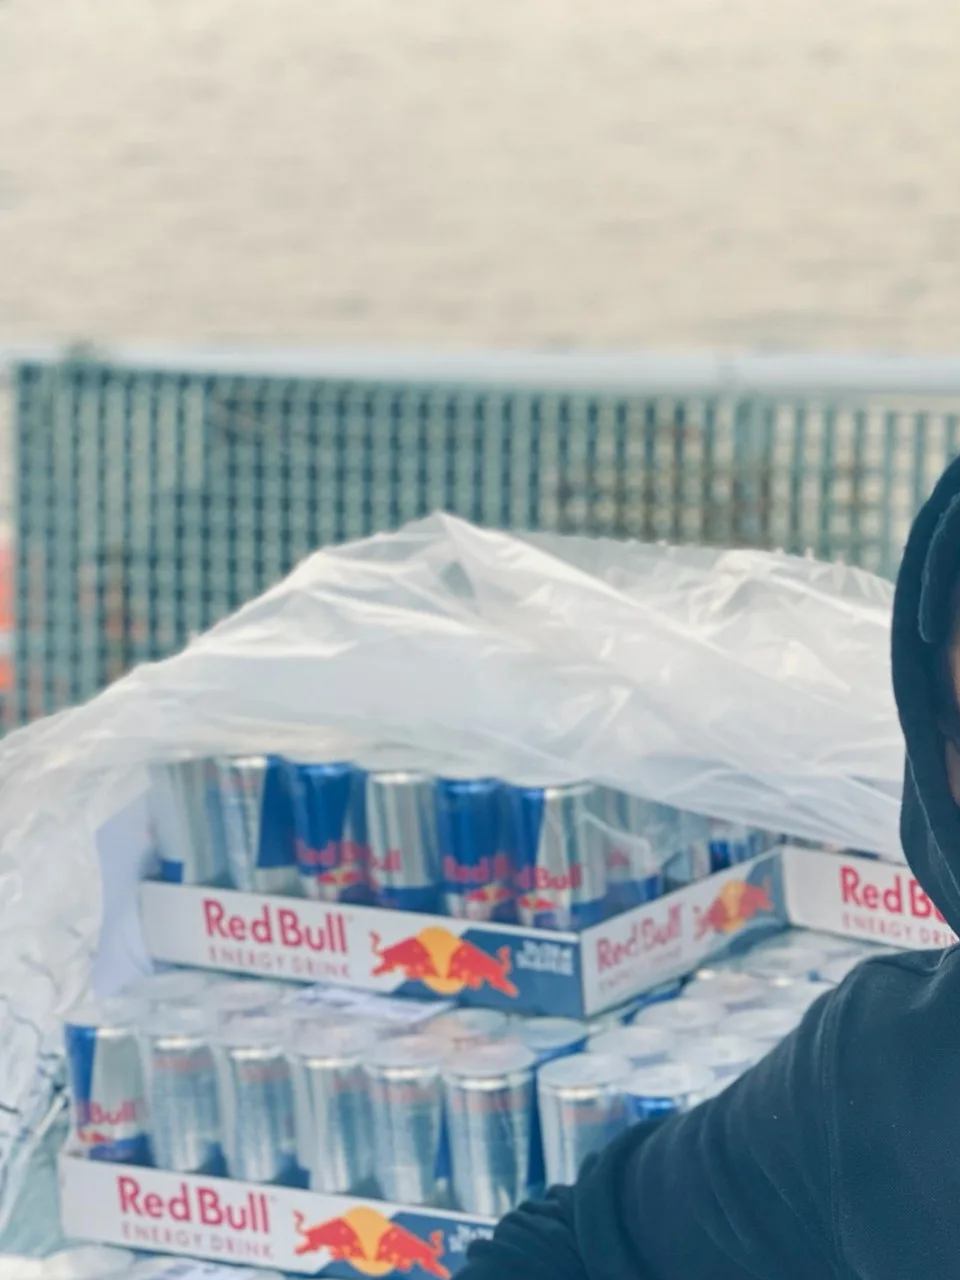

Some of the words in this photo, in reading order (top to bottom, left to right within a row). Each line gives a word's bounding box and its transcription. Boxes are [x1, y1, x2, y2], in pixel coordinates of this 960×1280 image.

[840, 865, 902, 914] Red
[203, 899, 273, 944] Red
[277, 908, 347, 954] Bull
[843, 914, 912, 940] ENERGY
[209, 945, 285, 971] ENERGY
[291, 957, 351, 978] DRINK
[116, 1175, 192, 1222] Red
[195, 1187, 270, 1234] Bull
[121, 1222, 203, 1248] ENERGY
[210, 1235, 273, 1259] DRINK
